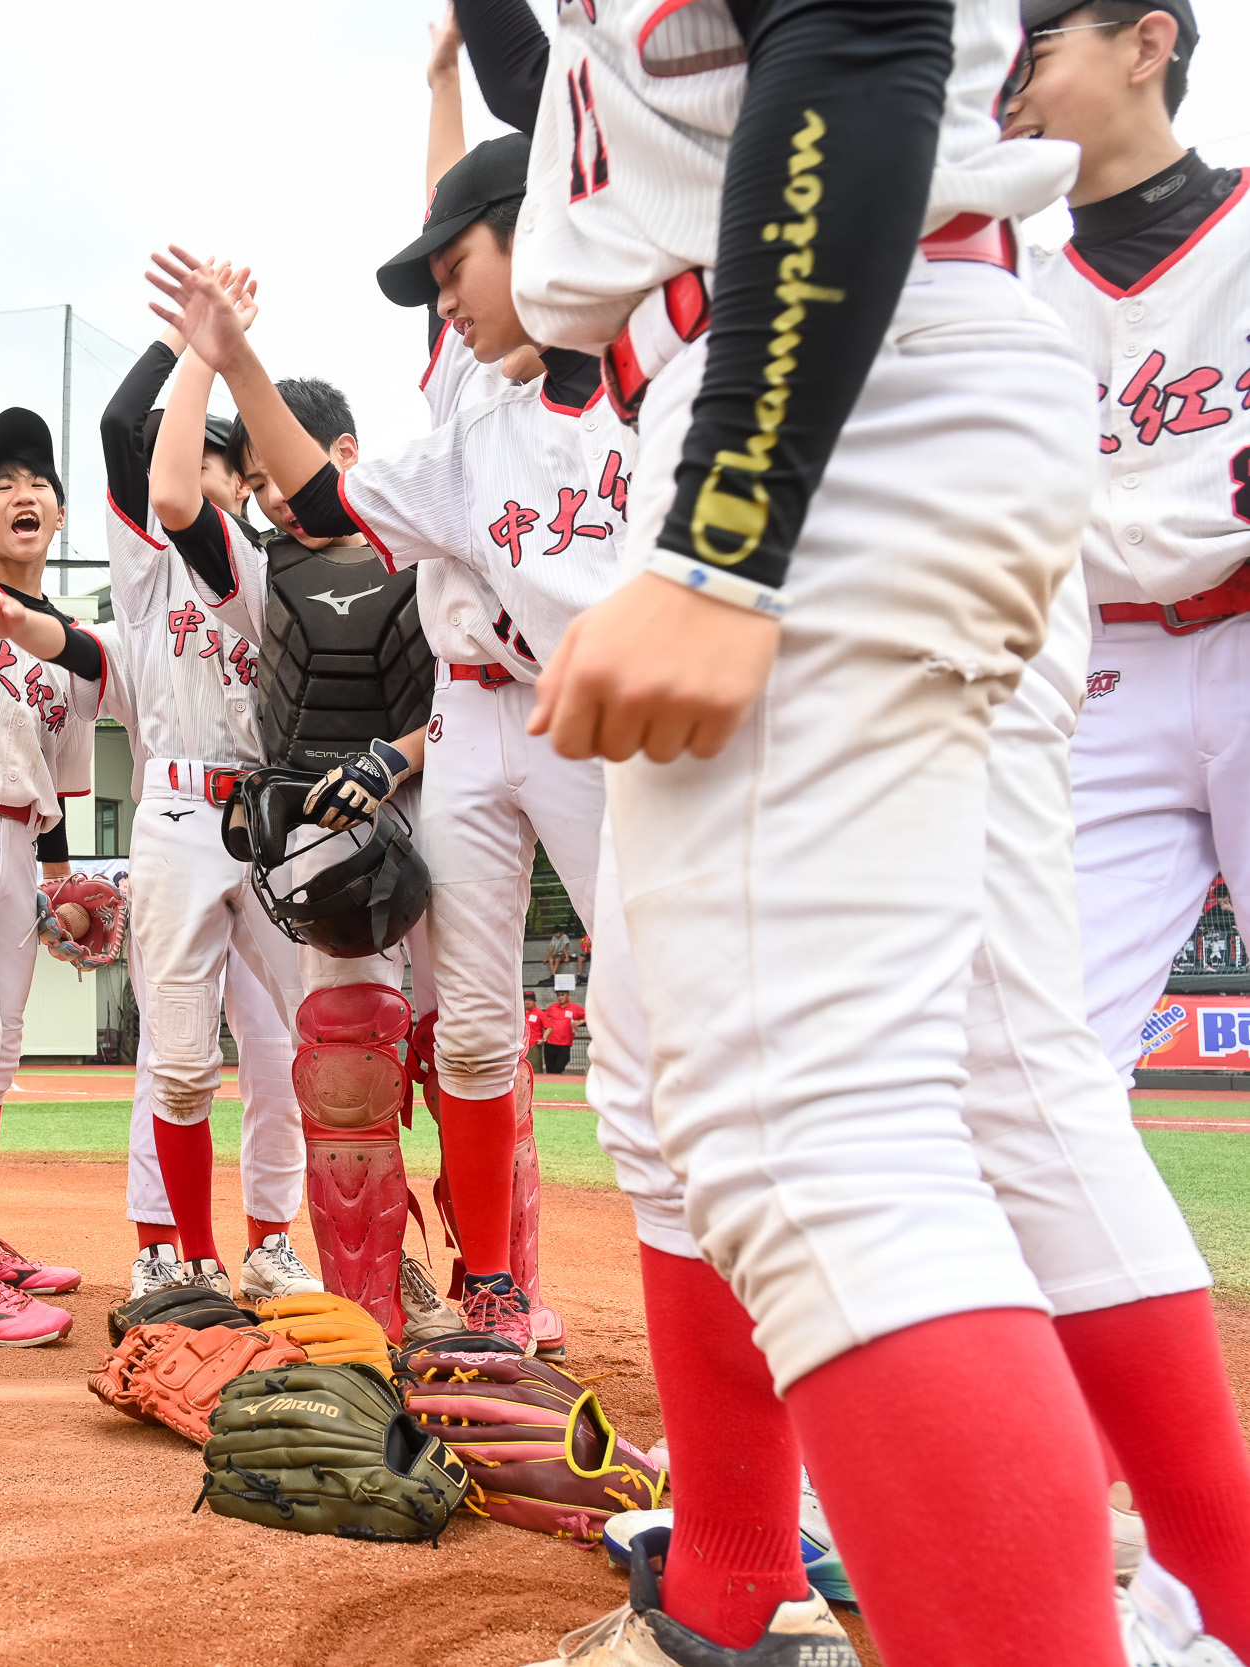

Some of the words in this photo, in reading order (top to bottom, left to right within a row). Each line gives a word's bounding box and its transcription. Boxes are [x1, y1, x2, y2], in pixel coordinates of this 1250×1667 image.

[690, 108, 845, 566] Champion
[1140, 1005, 1185, 1046] altine
[265, 1397, 340, 1419] MIZUNO
